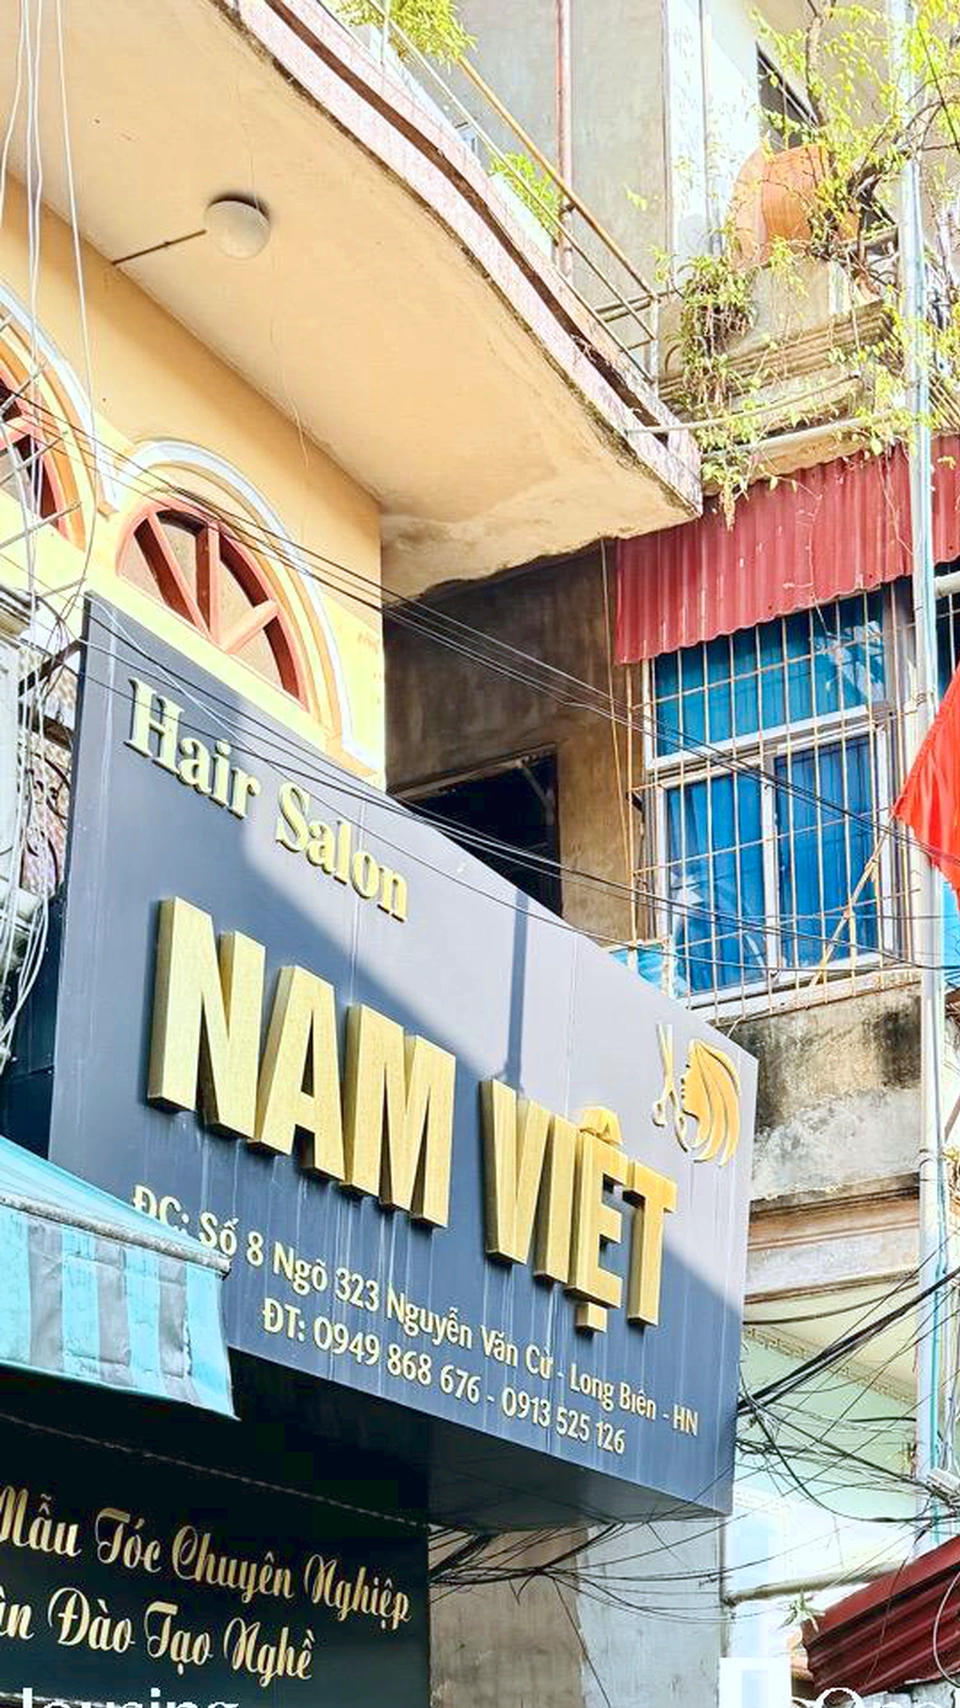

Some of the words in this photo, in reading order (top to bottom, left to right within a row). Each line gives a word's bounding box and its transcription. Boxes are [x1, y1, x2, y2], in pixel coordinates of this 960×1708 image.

[124, 678, 261, 819] Hair
[275, 781, 409, 923] Salon
[148, 896, 456, 1230] NAM
[479, 1079, 678, 1333] VIỆT
[131, 1184, 190, 1235] ĐC:
[199, 1210, 239, 1256] Số
[246, 1231, 264, 1267] 8
[273, 1241, 328, 1296] Ngõ
[335, 1267, 379, 1312] 323
[387, 1281, 473, 1350] Nguyễn
[481, 1324, 518, 1368] Văn
[570, 1363, 615, 1412] Long
[619, 1381, 656, 1421] Biên
[673, 1404, 699, 1437] HN
[262, 1298, 306, 1342] ĐT:
[313, 1316, 380, 1366] 0949
[387, 1343, 433, 1386] 868
[440, 1364, 481, 1405] 676
[502, 1386, 551, 1428] 0913
[556, 1406, 591, 1442] 525
[596, 1421, 626, 1455] 126
[47, 1587, 136, 1655] Đào
[143, 1600, 214, 1676] Tạo
[223, 1615, 317, 1688] Nghề
[95, 1507, 163, 1574] Tóc
[171, 1525, 296, 1604] Chuyên
[303, 1553, 411, 1631] Nghiệp
